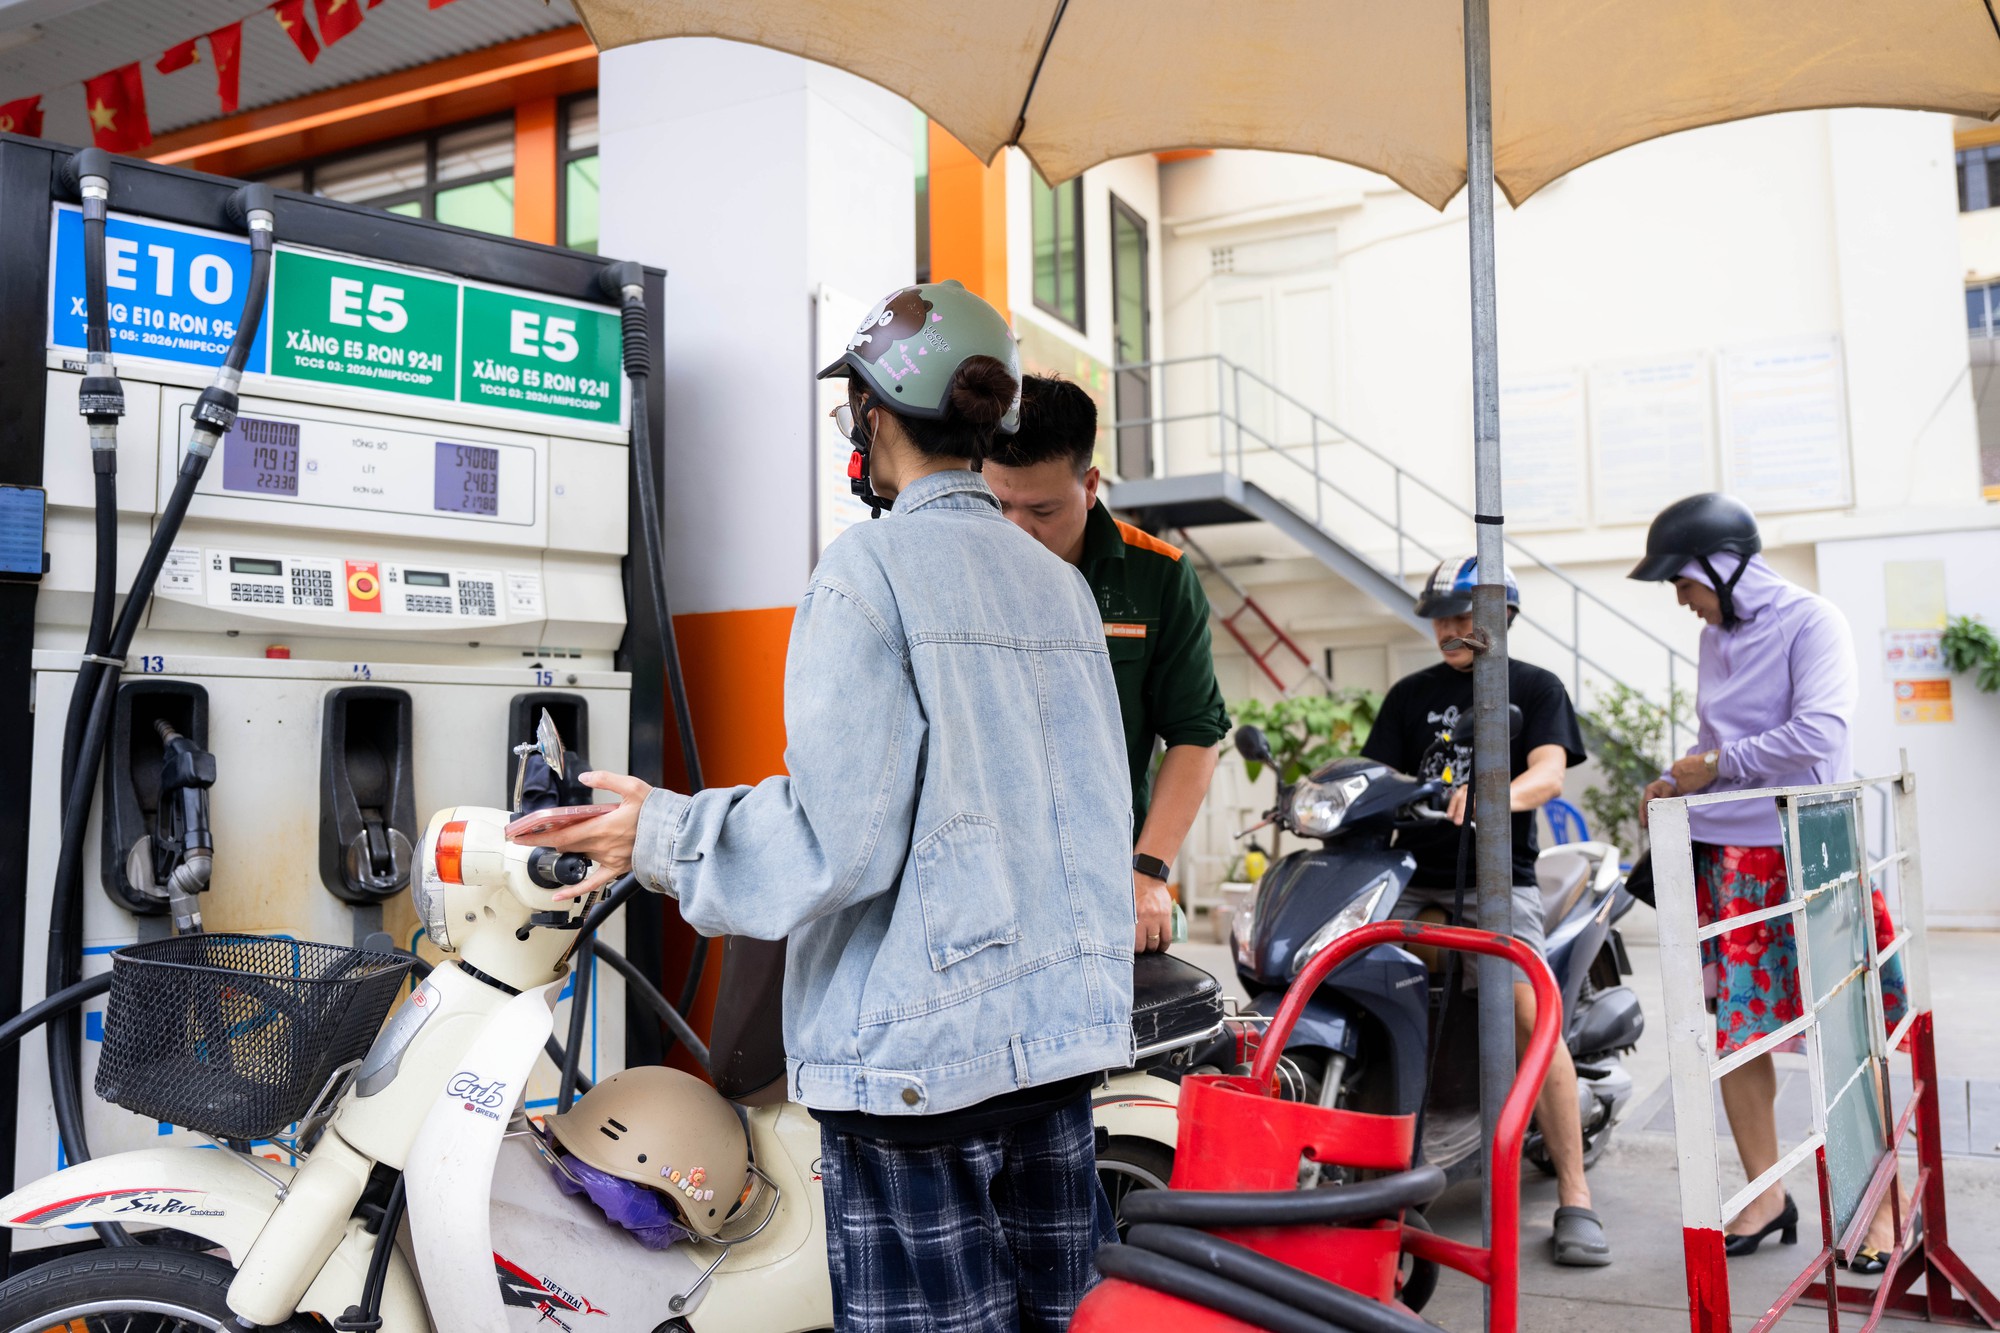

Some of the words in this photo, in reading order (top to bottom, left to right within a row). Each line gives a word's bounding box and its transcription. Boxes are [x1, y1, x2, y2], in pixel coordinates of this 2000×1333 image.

[104, 235, 234, 305] E10
[70, 297, 128, 323] XG
[132, 306, 165, 329] E10
[169, 312, 208, 336] RON
[212, 319, 237, 340] 95-
[329, 276, 409, 334] E5
[82, 323, 117, 339] TS
[119, 329, 139, 342] 05:
[142, 332, 232, 355] 2026/MIPECO
[510, 308, 580, 363] E5
[923, 328, 938, 347] YOU
[931, 328, 951, 352] LOVE
[285, 328, 340, 356] XĂNG
[343, 340, 363, 360] E5
[367, 343, 404, 366] RON
[407, 350, 443, 372] 92-II
[295, 355, 325, 370] TCCS
[327, 360, 345, 372] 03:
[347, 363, 433, 385] 2026/MIPECORP
[472, 358, 520, 384] XĂNG
[522, 368, 541, 388] E5
[543, 372, 576, 393] RON
[480, 383, 508, 397] TCCS
[525, 390, 602, 410] 2026/MIPECORP
[240, 420, 298, 447] 400000
[455, 446, 497, 470] 54080
[257, 472, 296, 490] 22330
[463, 471, 497, 494] 2.483
[462, 494, 497, 511] 21780
[141, 655, 164, 672] 13
[536, 671, 553, 687] 15
[447, 1071, 507, 1108] Cub
[475, 1107, 500, 1121] GREEN
[542, 1277, 562, 1295] VIET
[562, 1291, 583, 1310] THAI
